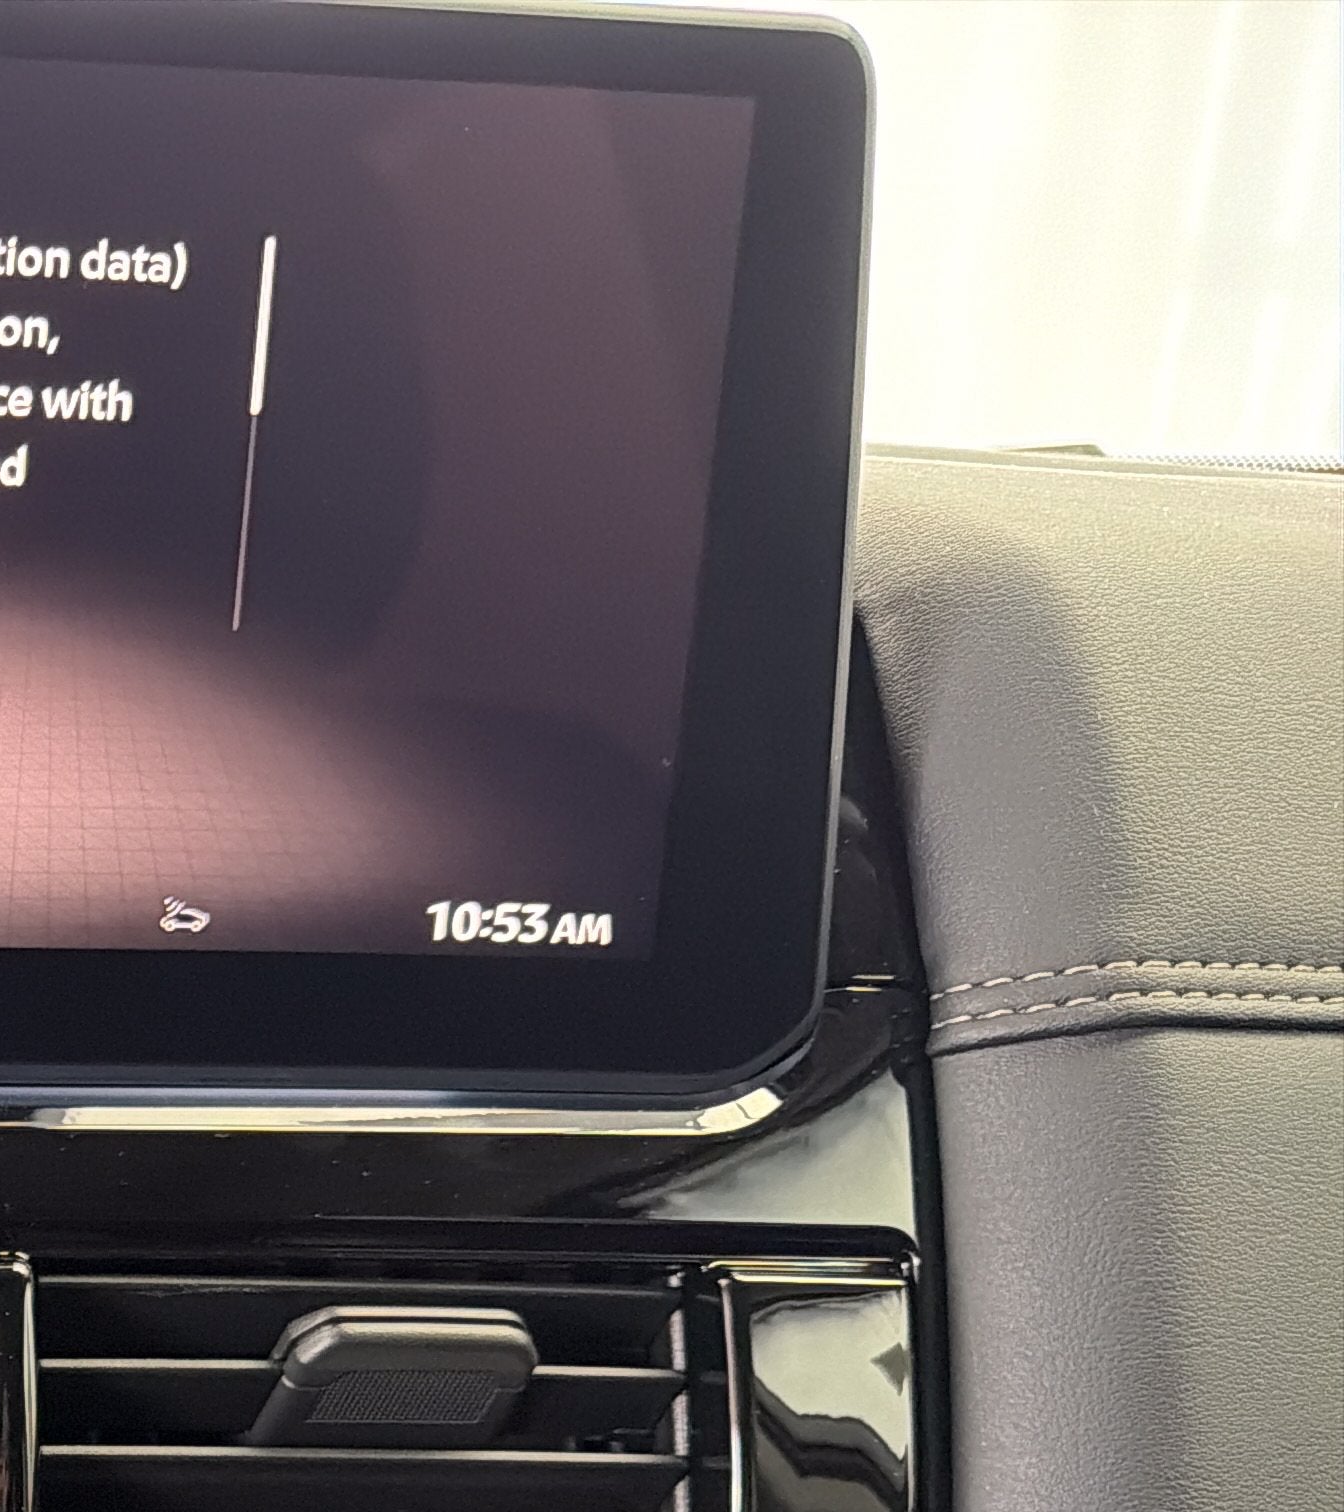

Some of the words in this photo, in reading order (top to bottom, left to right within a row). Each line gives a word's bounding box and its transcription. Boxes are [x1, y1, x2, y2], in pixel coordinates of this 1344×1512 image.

[80, 237, 188, 290] data)
[41, 378, 133, 422] with
[424, 901, 551, 944] 10:53
[549, 912, 613, 946] AM
